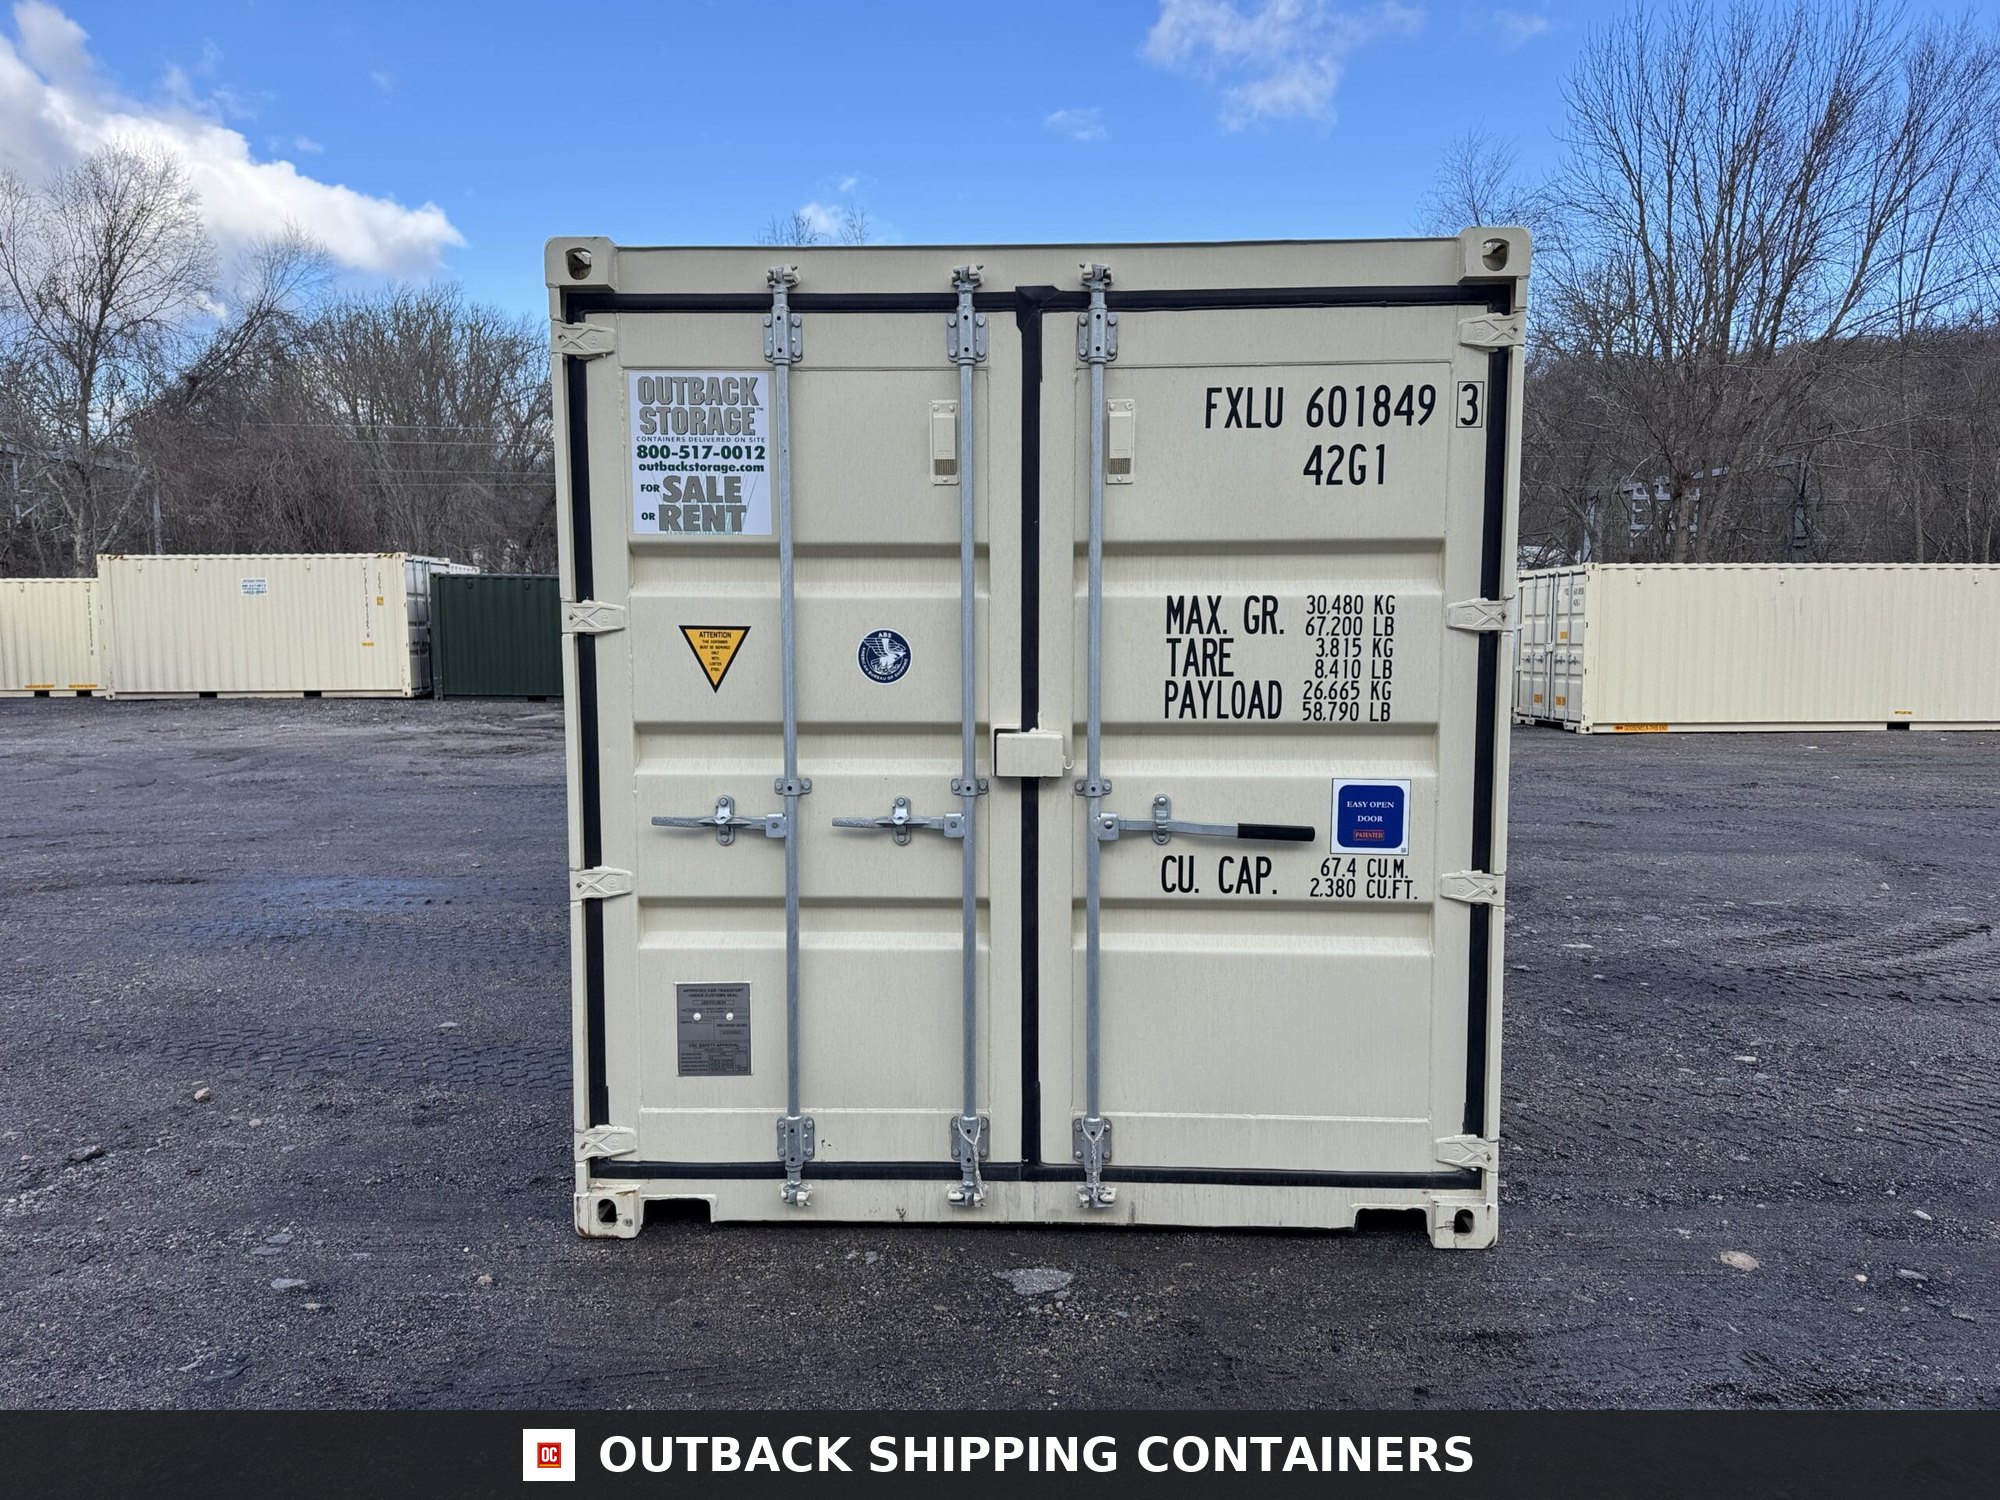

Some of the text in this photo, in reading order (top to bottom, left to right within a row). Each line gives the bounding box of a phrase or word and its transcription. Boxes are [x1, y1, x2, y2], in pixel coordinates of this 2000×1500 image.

[637, 376, 759, 406] OUTBACK
[1205, 384, 1478, 429] FXLU 601849 3
[639, 406, 756, 436] STORAGE
[636, 445, 765, 460] 800-517-0012
[1303, 444, 1385, 486] 42G1
[638, 461, 764, 474] outbackstorage.com
[640, 475, 742, 503] FOR SALE
[641, 504, 747, 532] OR RENT
[1166, 595, 1396, 635] MAX. GR. 30,480 KG
[1305, 616, 1394, 637] 67,200 LB
[1166, 638, 1393, 677] TARE 3,815 KG
[1314, 659, 1392, 680] 8,410 LB
[1164, 680, 1391, 719] PAYLOAD 26,665 KG
[1302, 701, 1391, 722] 58,790 LB
[1347, 801, 1394, 809] EASY OPEN
[1357, 815, 1383, 823] DOOR
[1355, 831, 1383, 839] PATENTED
[1161, 855, 1409, 895] CU. CAP. 67.4 CU.M.
[1310, 878, 1418, 900] 2,380 CU.FT.
